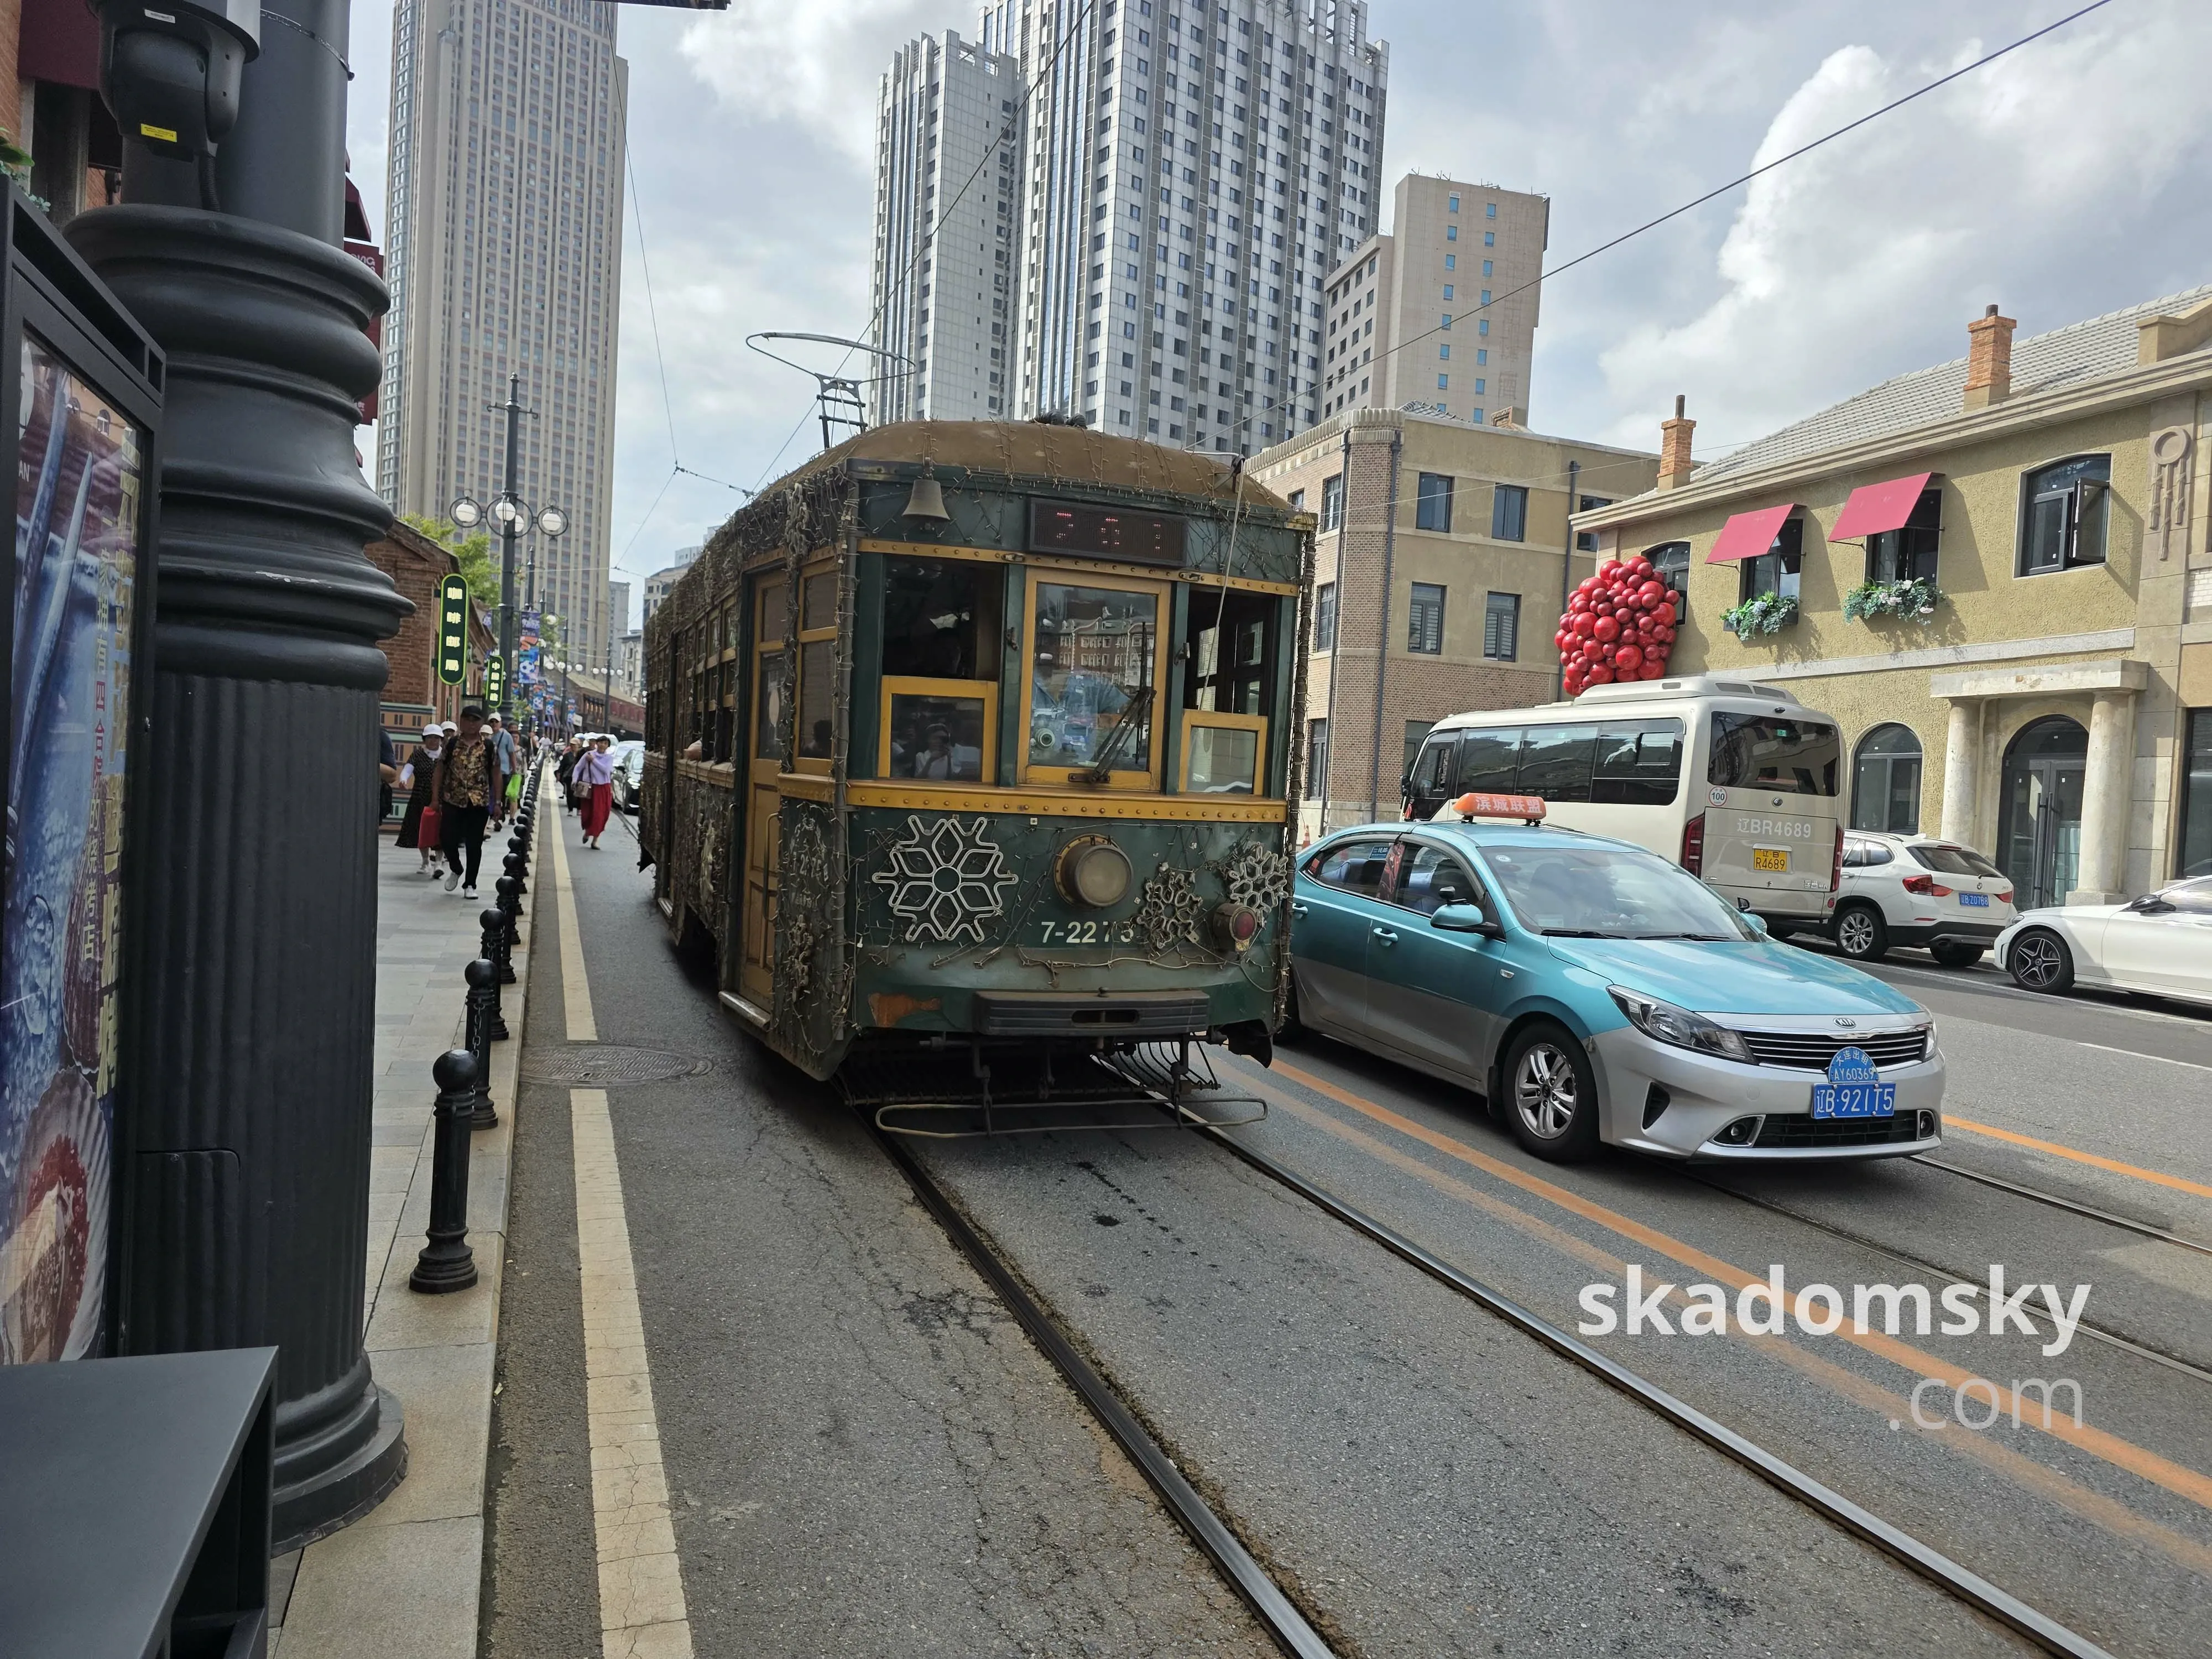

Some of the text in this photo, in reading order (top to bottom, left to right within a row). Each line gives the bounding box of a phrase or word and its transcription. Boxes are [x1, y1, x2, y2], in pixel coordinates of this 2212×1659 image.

[1712, 792, 1725, 801] 100
[1475, 795, 1542, 814] 滨城联盟
[1737, 817, 1812, 838] 辽BR4689
[1755, 858, 1785, 870] R4689
[1837, 1018, 1855, 1026] KIA
[1835, 1050, 1869, 1067] 大连出租
[1834, 1067, 1875, 1081] AY60369
